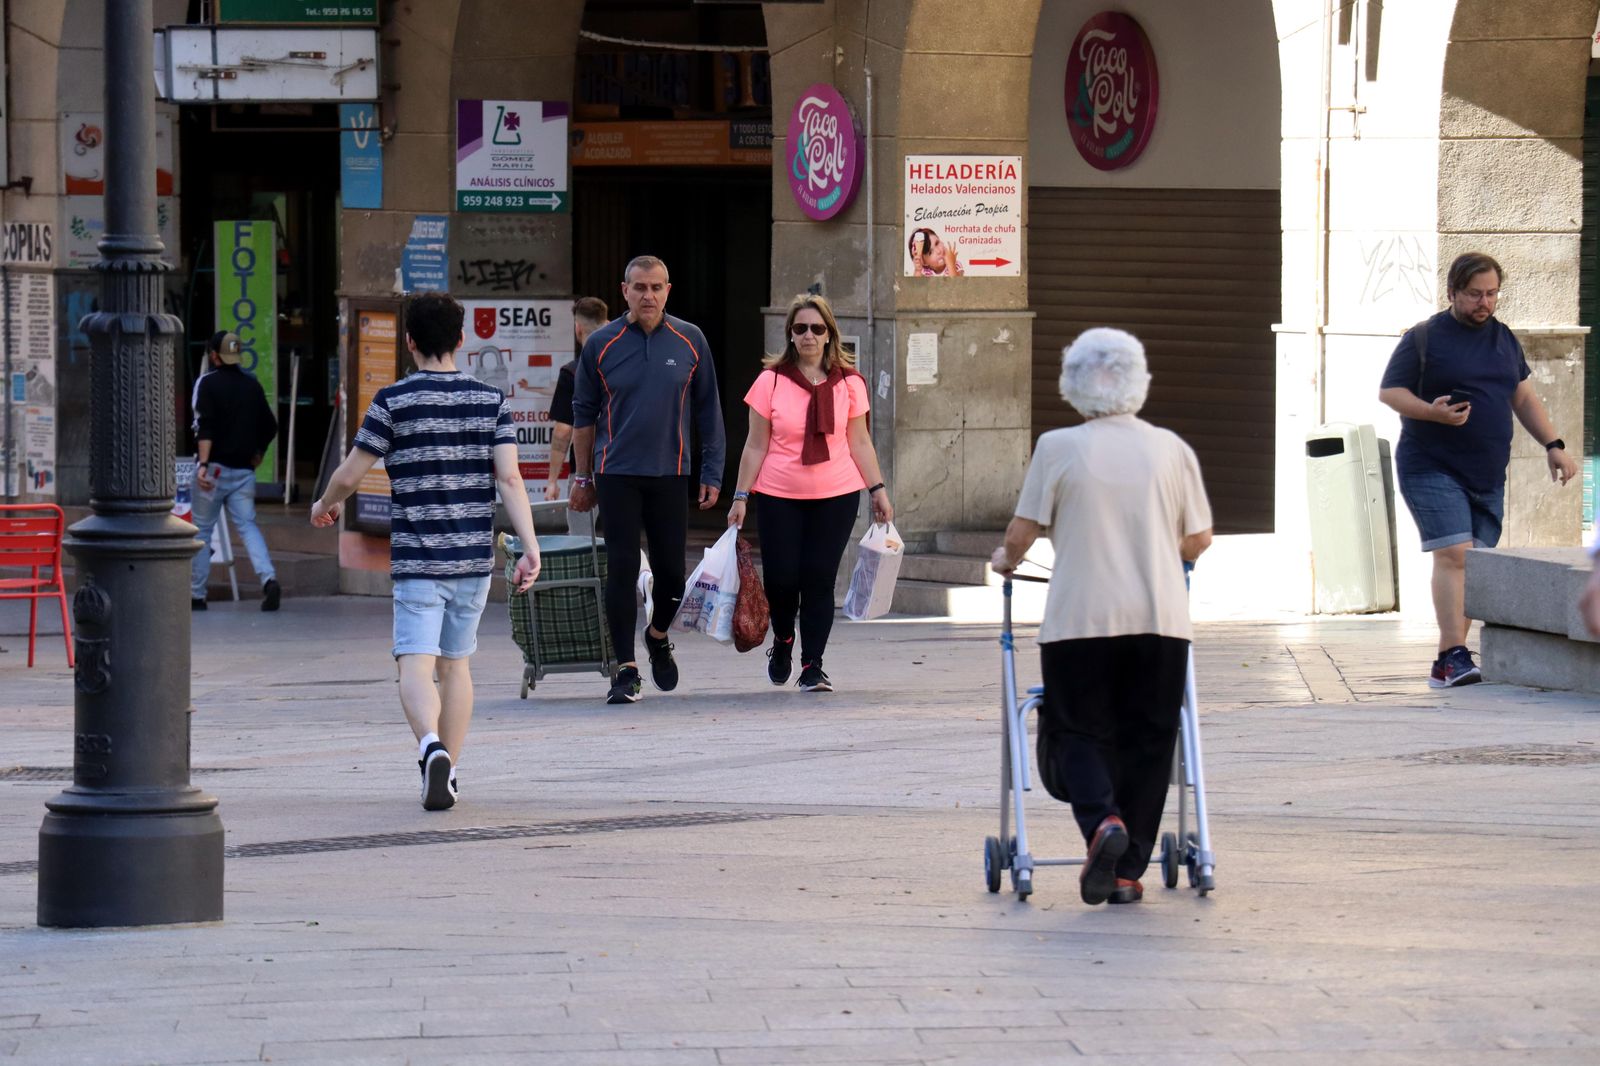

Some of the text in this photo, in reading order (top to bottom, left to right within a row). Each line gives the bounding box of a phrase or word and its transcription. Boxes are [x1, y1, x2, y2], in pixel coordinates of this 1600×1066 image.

[1080, 29, 1127, 87] Taco
[1088, 67, 1138, 138] Roll
[799, 97, 837, 146] Taco
[739, 124, 756, 133] TODO
[587, 132, 624, 145] ALQUILER
[739, 136, 744, 144] A
[745, 136, 764, 144] COSTE
[584, 147, 632, 160] ACORAZADO
[805, 133, 845, 191] Roll
[910, 160, 1017, 180] HELADERÍA
[470, 177, 555, 188] ANÁLISIS CLÍNICOS
[911, 184, 1016, 194] Helados Valencianos
[463, 196, 524, 206] 959 248 923
[914, 203, 1009, 221] Elaboración Propia
[945, 225, 1016, 233] Horchata de chufa
[959, 237, 1002, 245] Granizadas
[500, 308, 551, 326] SEAG
[527, 411, 537, 422] EL
[538, 411, 551, 422] CO
